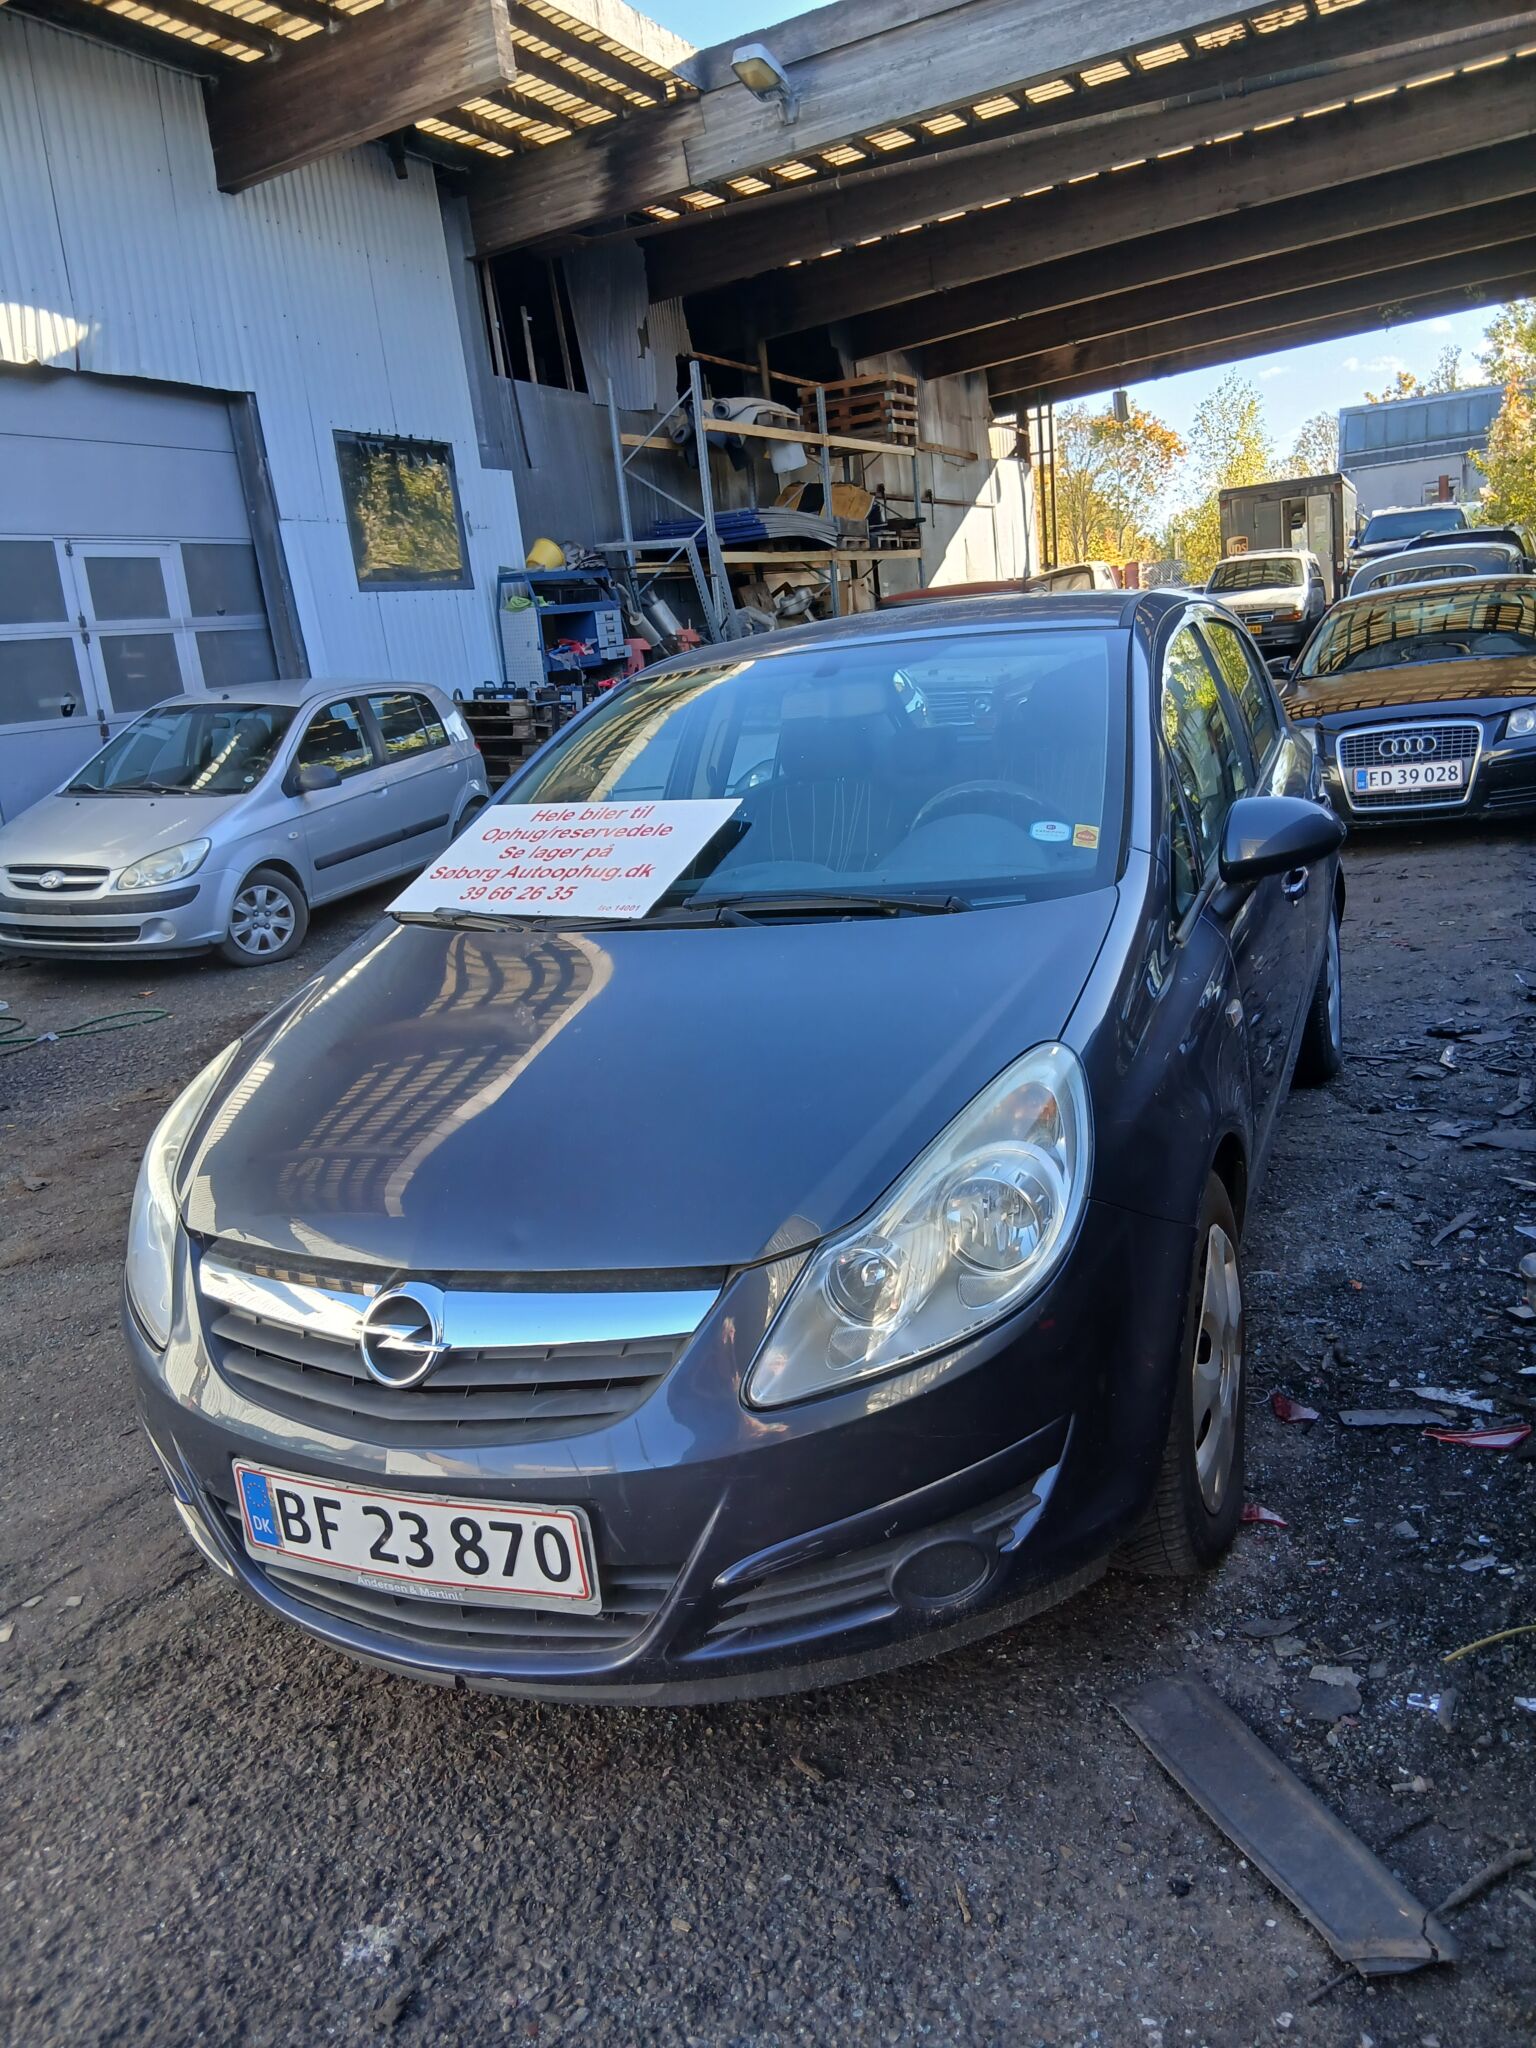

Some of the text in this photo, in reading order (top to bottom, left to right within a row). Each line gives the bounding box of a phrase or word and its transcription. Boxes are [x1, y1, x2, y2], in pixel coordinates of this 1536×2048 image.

[1397, 769, 1419, 784] 39
[1424, 765, 1458, 782] 028
[531, 804, 655, 823] Hele biler til
[481, 823, 674, 843] Ophug/reservedele
[499, 843, 614, 863] Se lager på
[430, 864, 657, 882] Søborg Autoophug.dk
[459, 886, 578, 900] 39 66 26 35
[252, 1514, 273, 1535] DK
[274, 1487, 572, 1583] BF 23 870
[357, 1575, 408, 1594] Andersen
[409, 1586, 418, 1595] &
[419, 1587, 459, 1600] Martini
